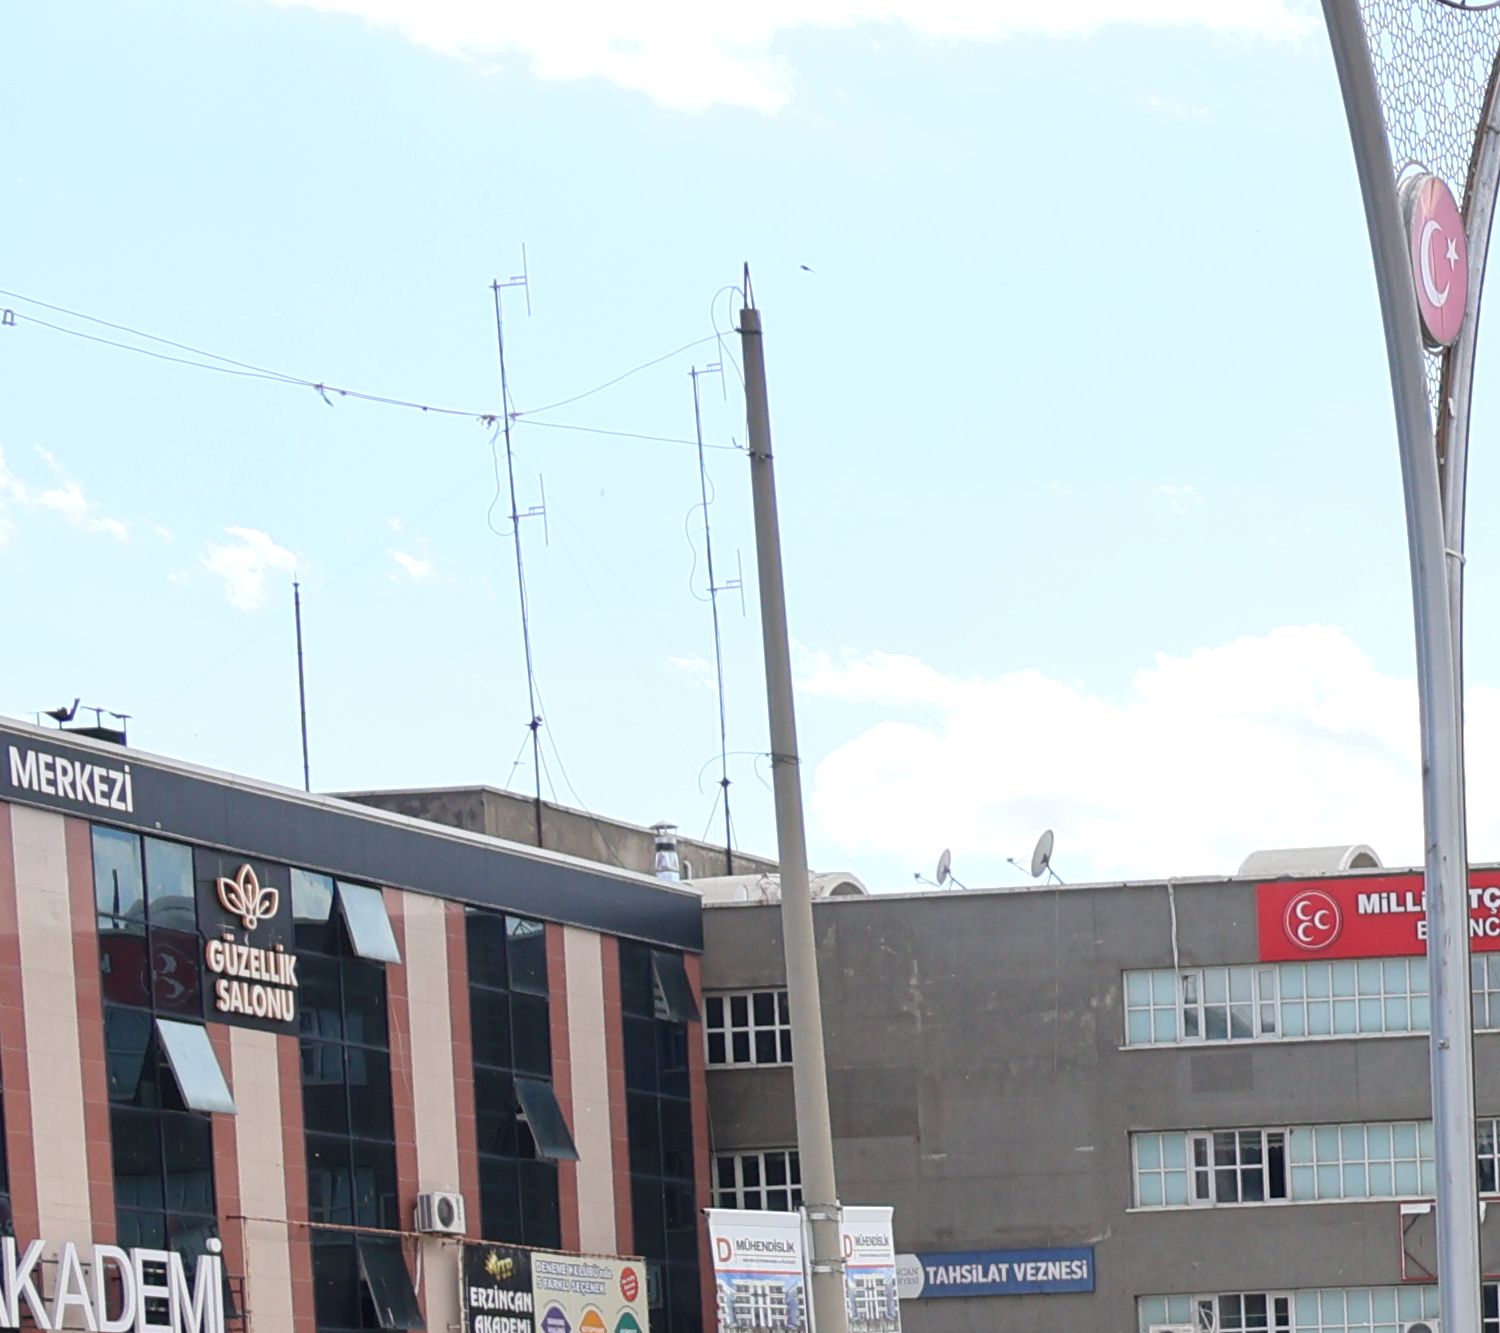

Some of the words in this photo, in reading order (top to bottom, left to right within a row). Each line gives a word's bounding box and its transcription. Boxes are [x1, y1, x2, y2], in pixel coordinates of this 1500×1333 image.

[8, 744, 133, 813] MERKEZİ
[207, 939, 299, 988] GÜZELLİK
[216, 979, 295, 1022] SALONU
[736, 1238, 795, 1253] MÜHENDİSLİK
[926, 1263, 1009, 1285] TAHSİLAT
[1014, 1260, 1088, 1282] VEZNESİ
[470, 1285, 532, 1314] ERZİNCAN
